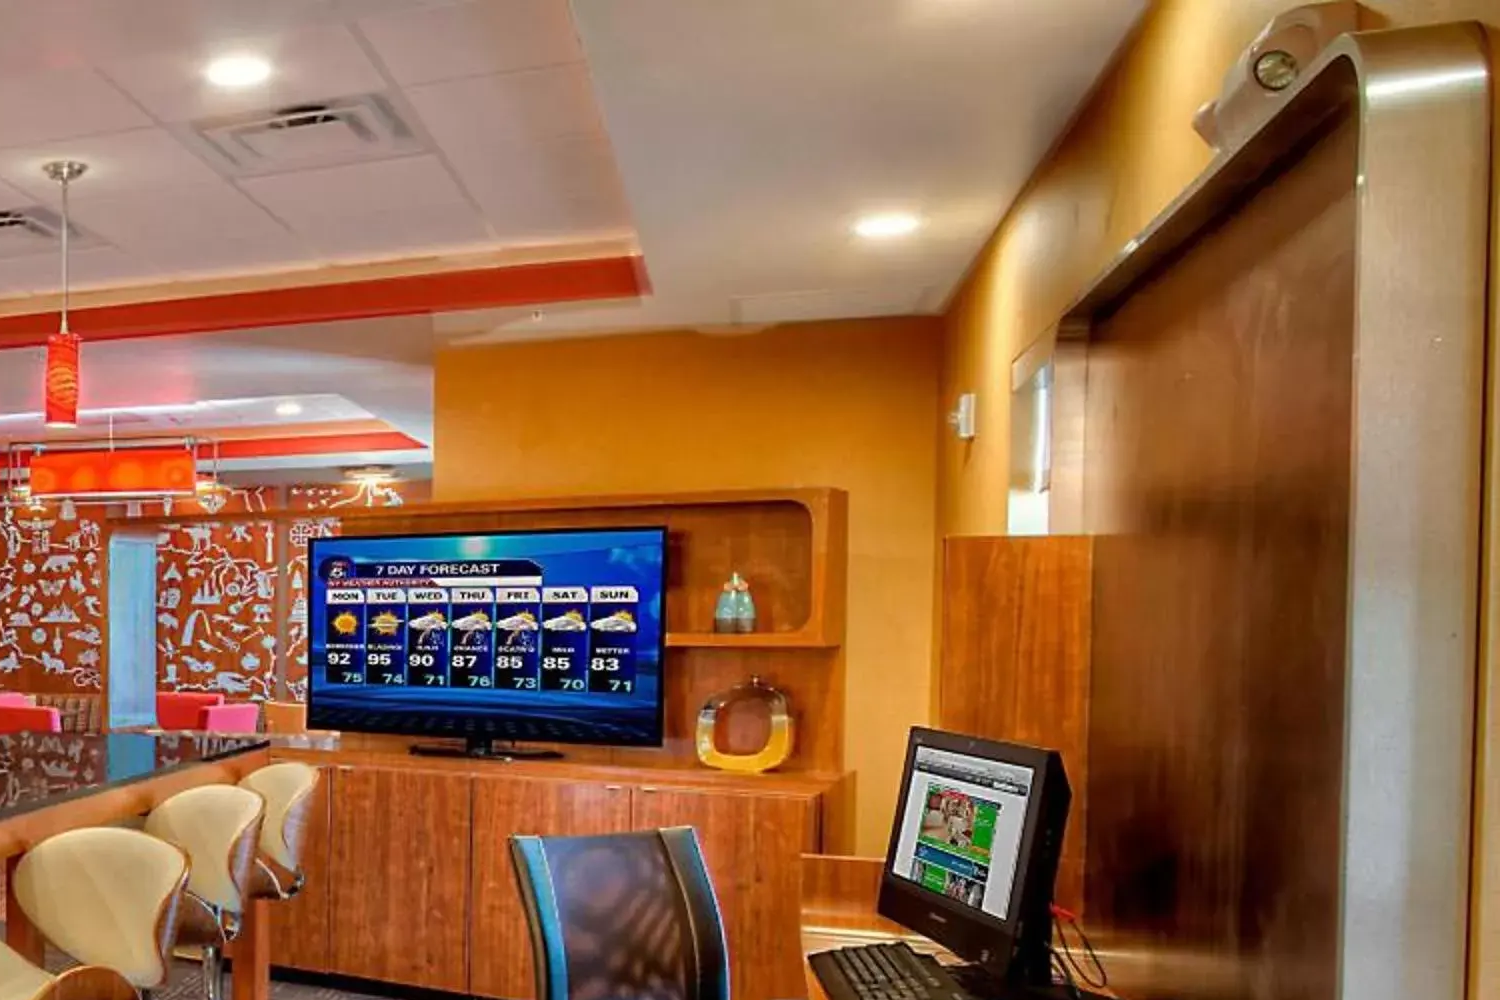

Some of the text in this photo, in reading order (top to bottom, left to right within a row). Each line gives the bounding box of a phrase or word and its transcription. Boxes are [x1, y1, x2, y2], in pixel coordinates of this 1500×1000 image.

[376, 563, 501, 576] 7 DAY FORECAST
[332, 590, 630, 600] MON TUE WED THU FRI SAT SUN
[327, 652, 351, 665] 92
[367, 653, 391, 666] 95
[409, 654, 434, 667] 90
[451, 655, 478, 668] 87
[543, 657, 570, 670] 85
[591, 658, 619, 671] 83
[342, 672, 363, 683] 75
[383, 673, 404, 684] 74
[425, 674, 444, 686] 71
[513, 677, 536, 689] 73
[560, 678, 584, 690] 70
[609, 680, 632, 692] 71
